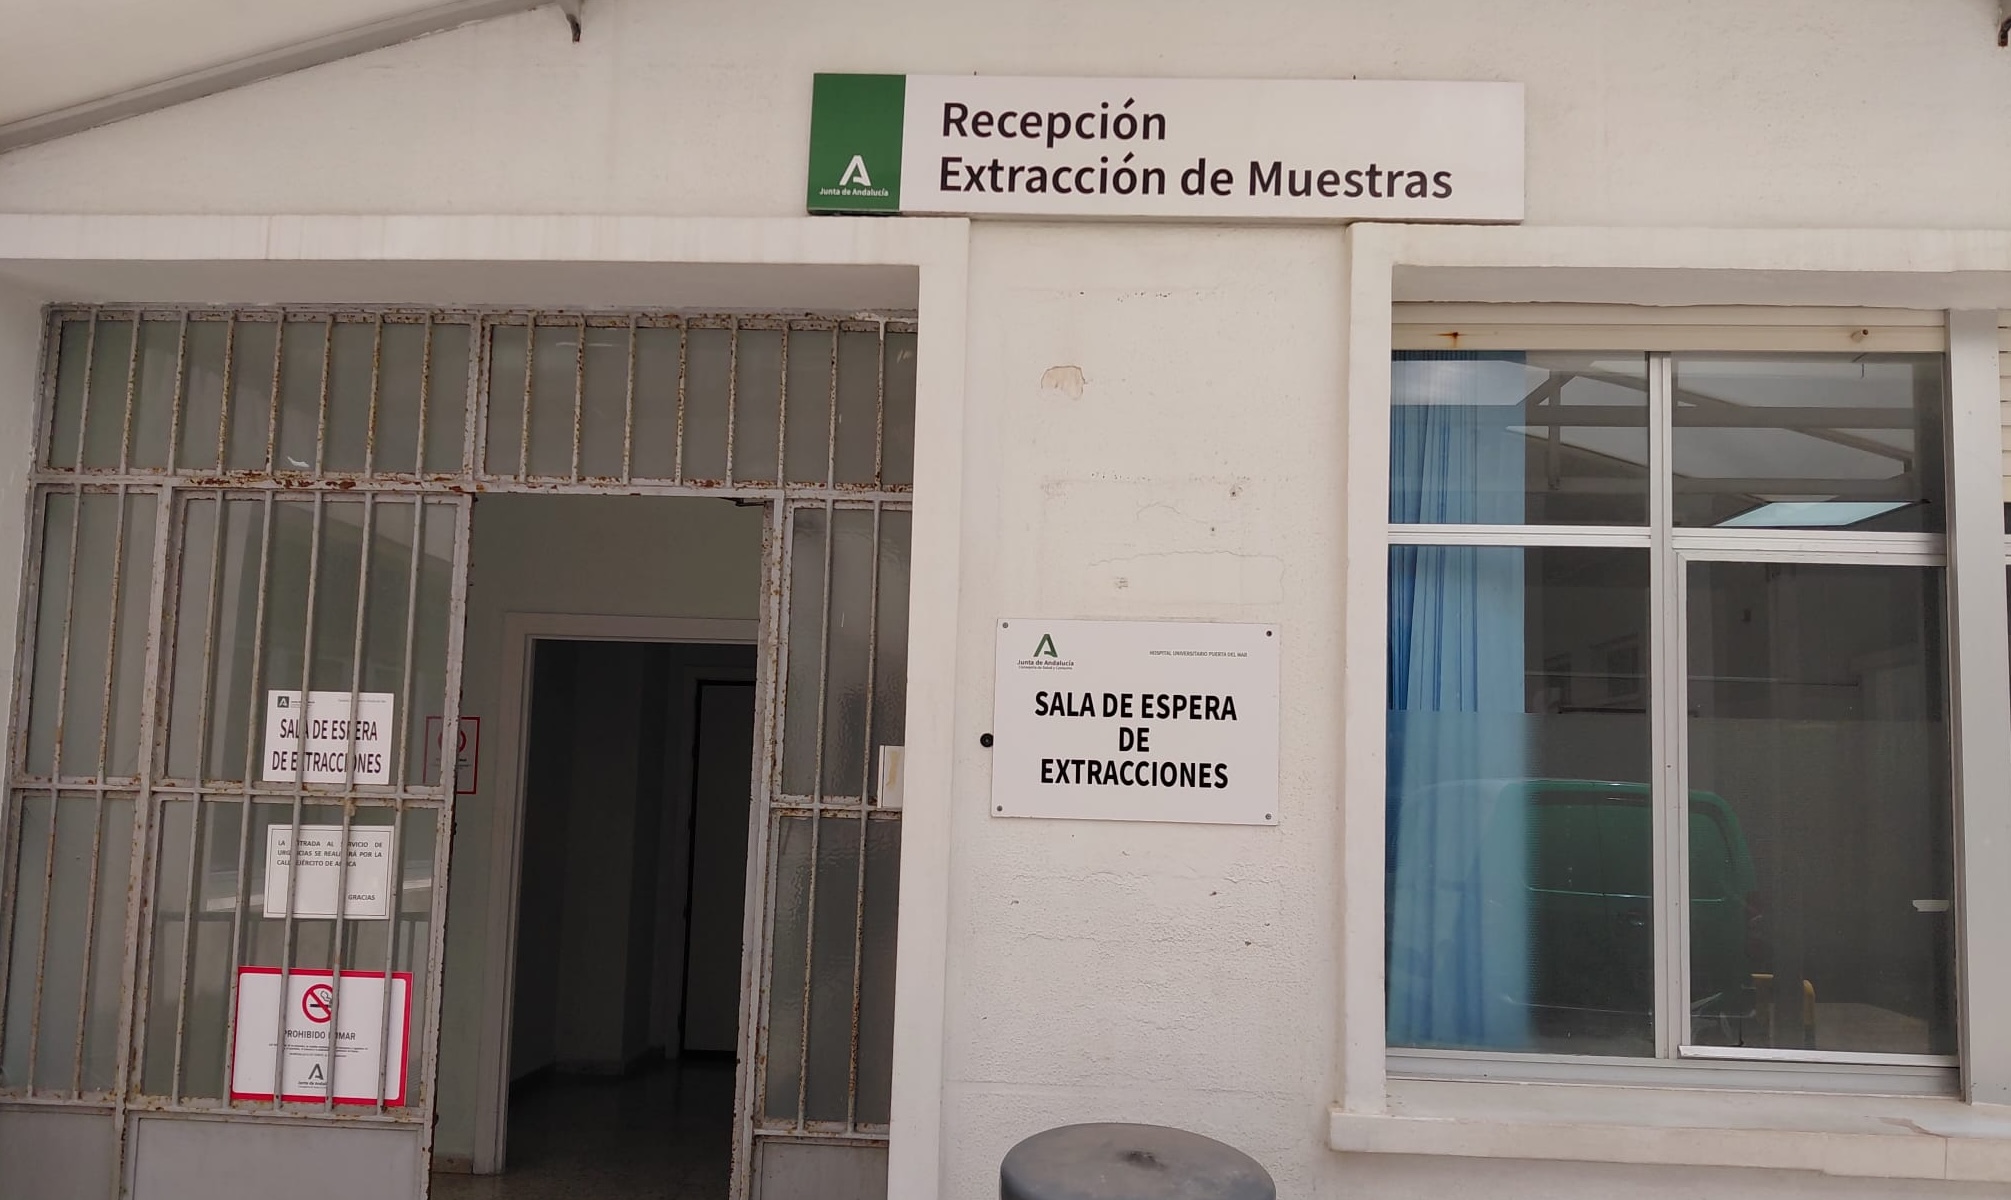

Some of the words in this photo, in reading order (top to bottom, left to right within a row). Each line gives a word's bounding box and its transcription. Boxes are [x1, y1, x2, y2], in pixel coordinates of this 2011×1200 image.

[942, 97, 1166, 149] Recepción
[940, 151, 1166, 195] Extracción
[1180, 157, 1234, 196] de
[1249, 160, 1453, 199] Muestras
[819, 187, 840, 196] Junta
[841, 187, 851, 196] de
[852, 187, 889, 197] Andalucía
[1017, 659, 1034, 667] Junta
[1044, 659, 1075, 668] Andalucía
[1034, 690, 1096, 718] SALA
[1102, 692, 1134, 719] DE
[1141, 693, 1238, 721] ESPERA
[313, 720, 328, 740] DE
[1118, 726, 1150, 753] DE
[271, 751, 288, 771] DE
[290, 751, 382, 774] ETRACCINES
[1040, 758, 1229, 789] EXTRACCIONES
[277, 849, 313, 857] URGCIAS
[323, 849, 357, 858] REALIRÁ
[296, 840, 321, 848] TRADA
[276, 859, 291, 867] CALL
[329, 1031, 356, 1041] MAR
